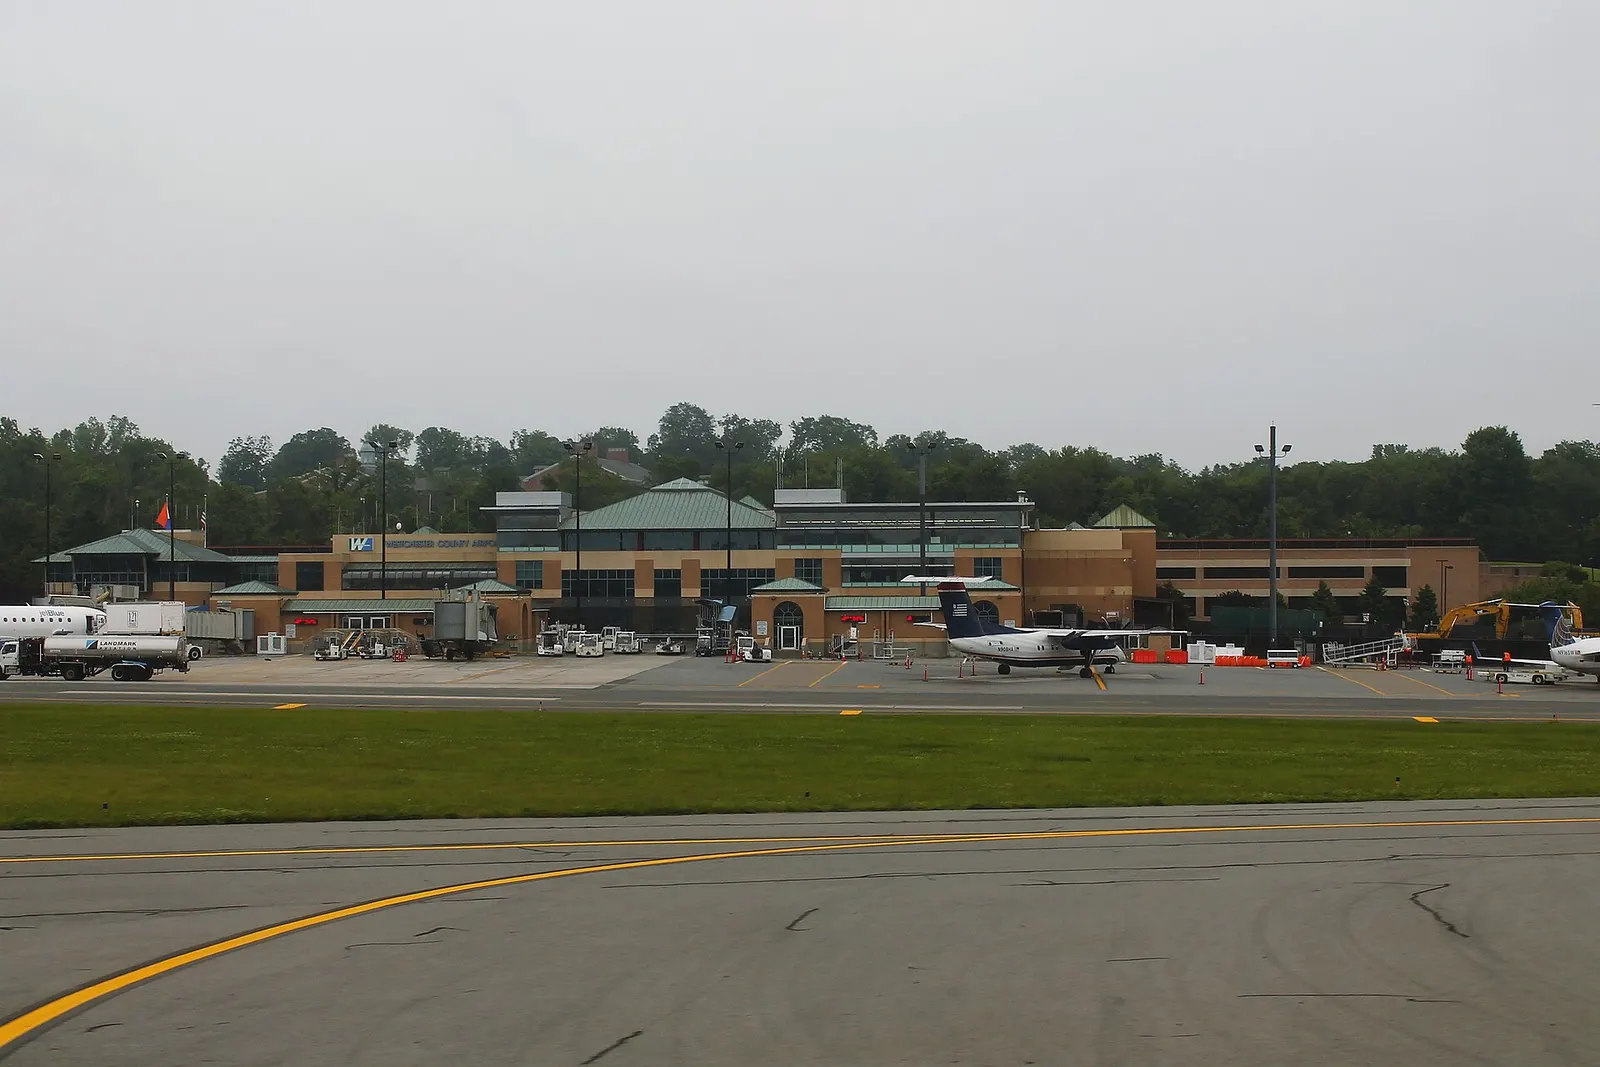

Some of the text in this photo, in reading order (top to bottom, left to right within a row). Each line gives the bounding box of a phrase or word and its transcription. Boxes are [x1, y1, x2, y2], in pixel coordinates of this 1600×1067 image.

[386, 540, 497, 548] WESTCHESTER COUNTY AIRPO
[39, 609, 65, 617] jetBlue
